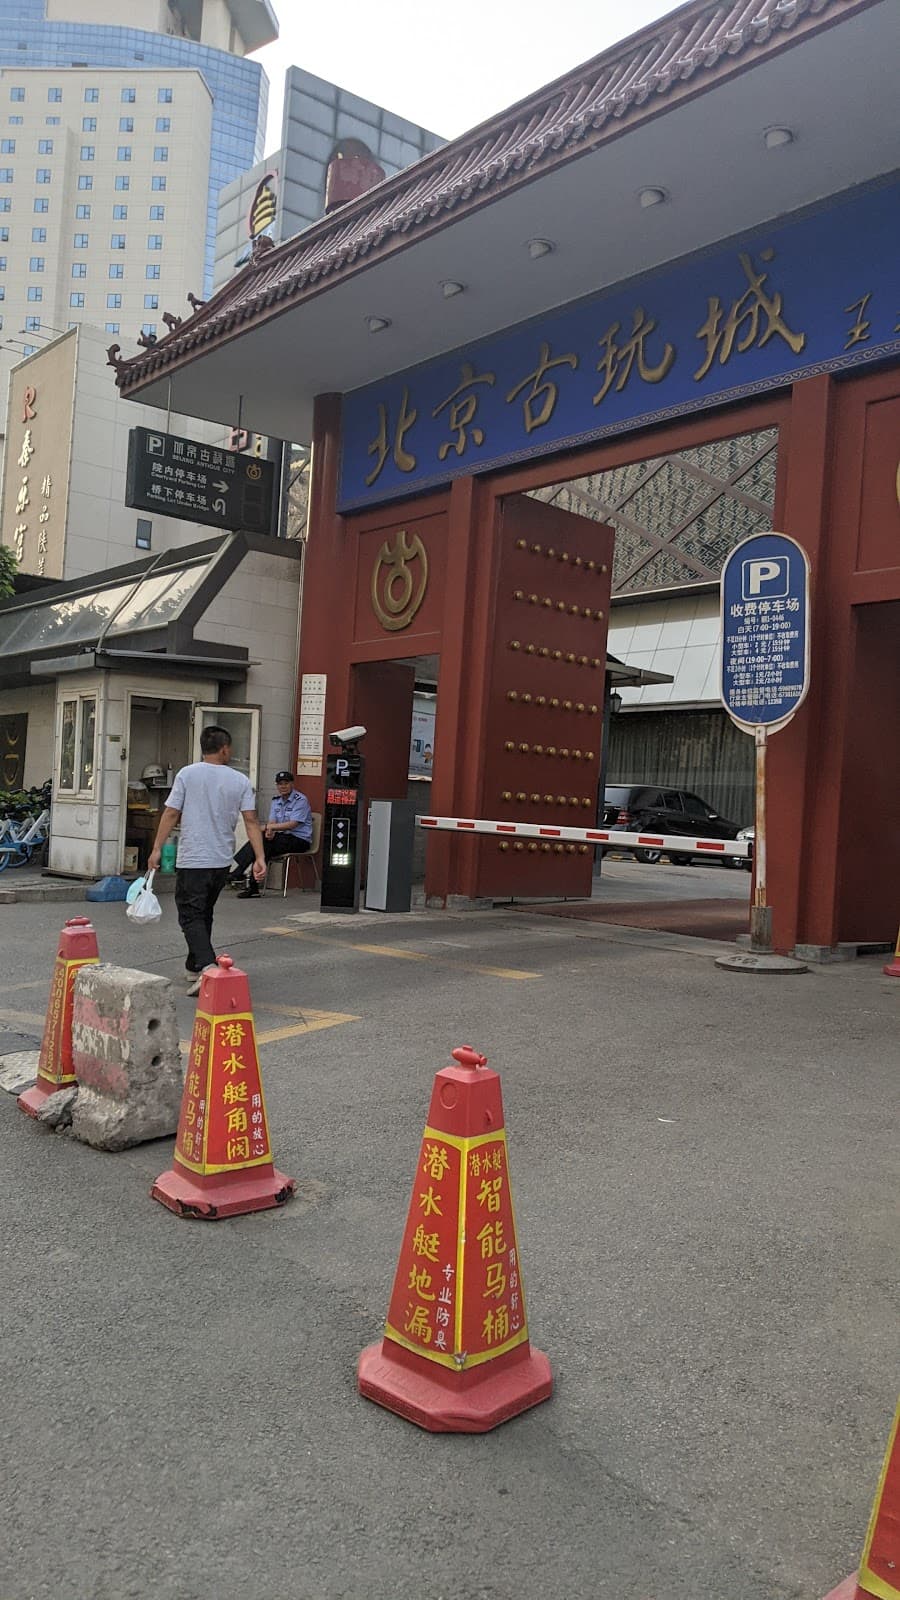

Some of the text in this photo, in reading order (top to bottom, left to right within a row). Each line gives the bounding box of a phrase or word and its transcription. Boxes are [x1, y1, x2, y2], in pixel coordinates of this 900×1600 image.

[365, 248, 804, 487] 北京古玩城
[149, 436, 162, 453] P
[152, 462, 207, 484] 院内停车场
[151, 483, 207, 505] 桥下停车场
[730, 598, 799, 617] 收费停车场
[749, 561, 780, 595] P
[183, 1043, 204, 1156] 智能马桶
[220, 1023, 250, 1161] 潜水艇角阀
[251, 1093, 265, 1156] 用的放心
[469, 1146, 503, 1177] 潜水艇
[402, 1143, 451, 1345] 潜水艇地漏
[476, 1176, 510, 1345] 智能马桶
[434, 1263, 455, 1351] 专业防臭
